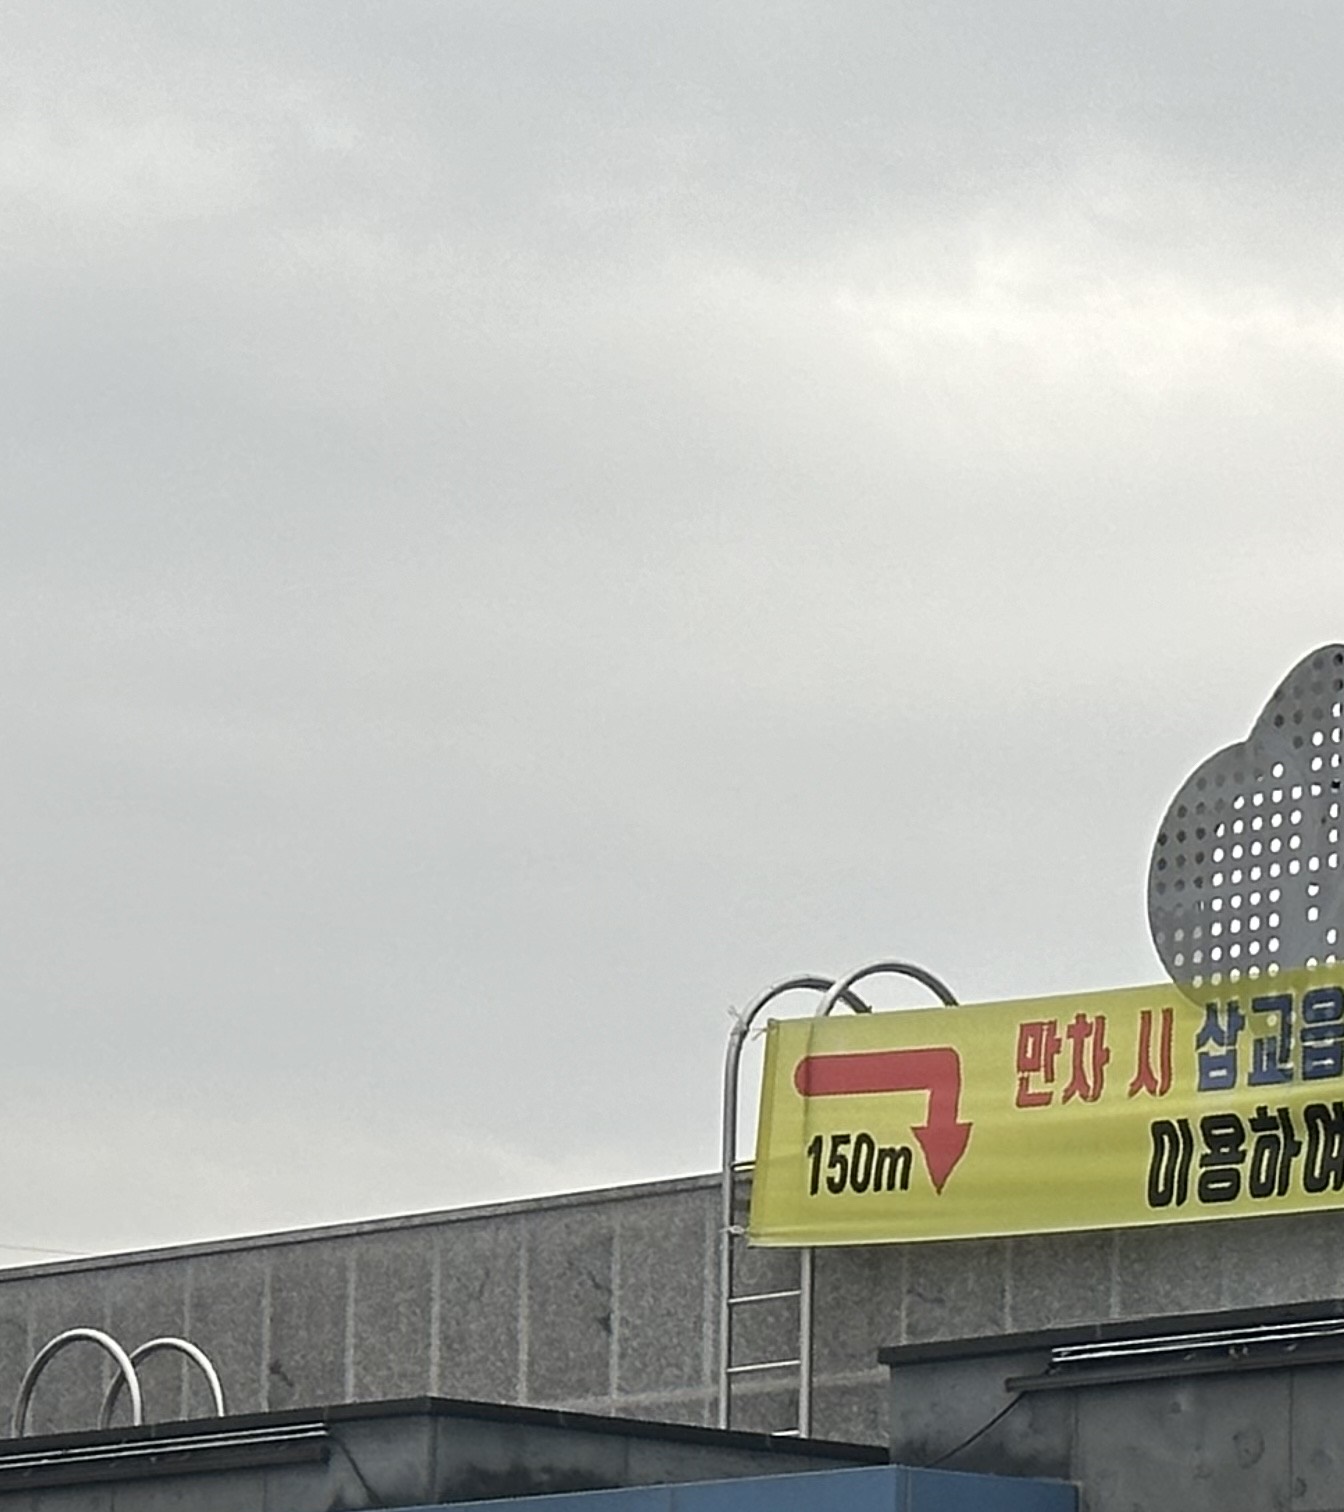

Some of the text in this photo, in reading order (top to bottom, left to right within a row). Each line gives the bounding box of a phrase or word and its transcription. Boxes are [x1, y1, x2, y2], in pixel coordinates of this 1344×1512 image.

[1015, 985, 1344, 1109] 만차 시 삽교읍
[807, 1131, 913, 1196] 150m
[1147, 1101, 1344, 1208] 이용하여
